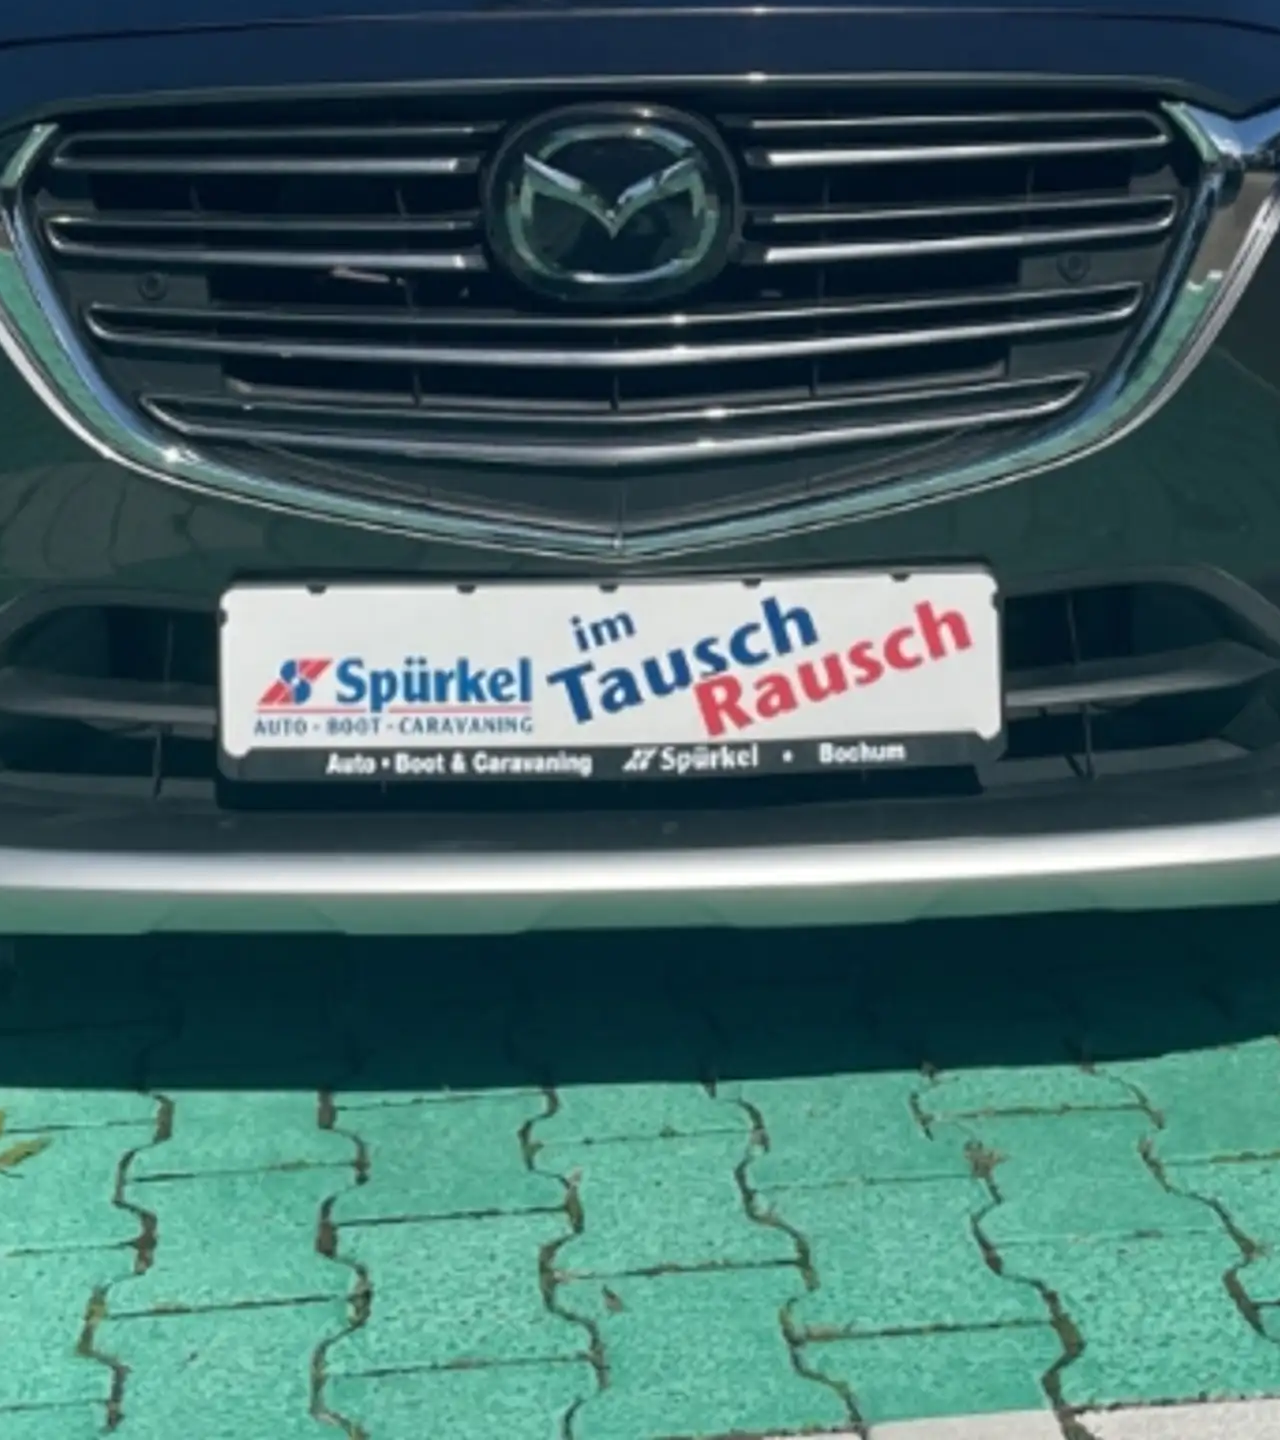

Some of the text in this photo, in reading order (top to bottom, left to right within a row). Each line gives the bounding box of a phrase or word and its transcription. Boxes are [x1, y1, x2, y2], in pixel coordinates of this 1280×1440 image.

[571, 610, 637, 652] im
[546, 596, 820, 724] Tausch
[694, 600, 973, 738] Rausch
[336, 656, 532, 713] Spürkel
[254, 714, 534, 736] AUTO BOOT CARAVANING
[326, 750, 593, 778] Auto Boot & Caravaning
[659, 742, 907, 774] Spürkel Bochum
